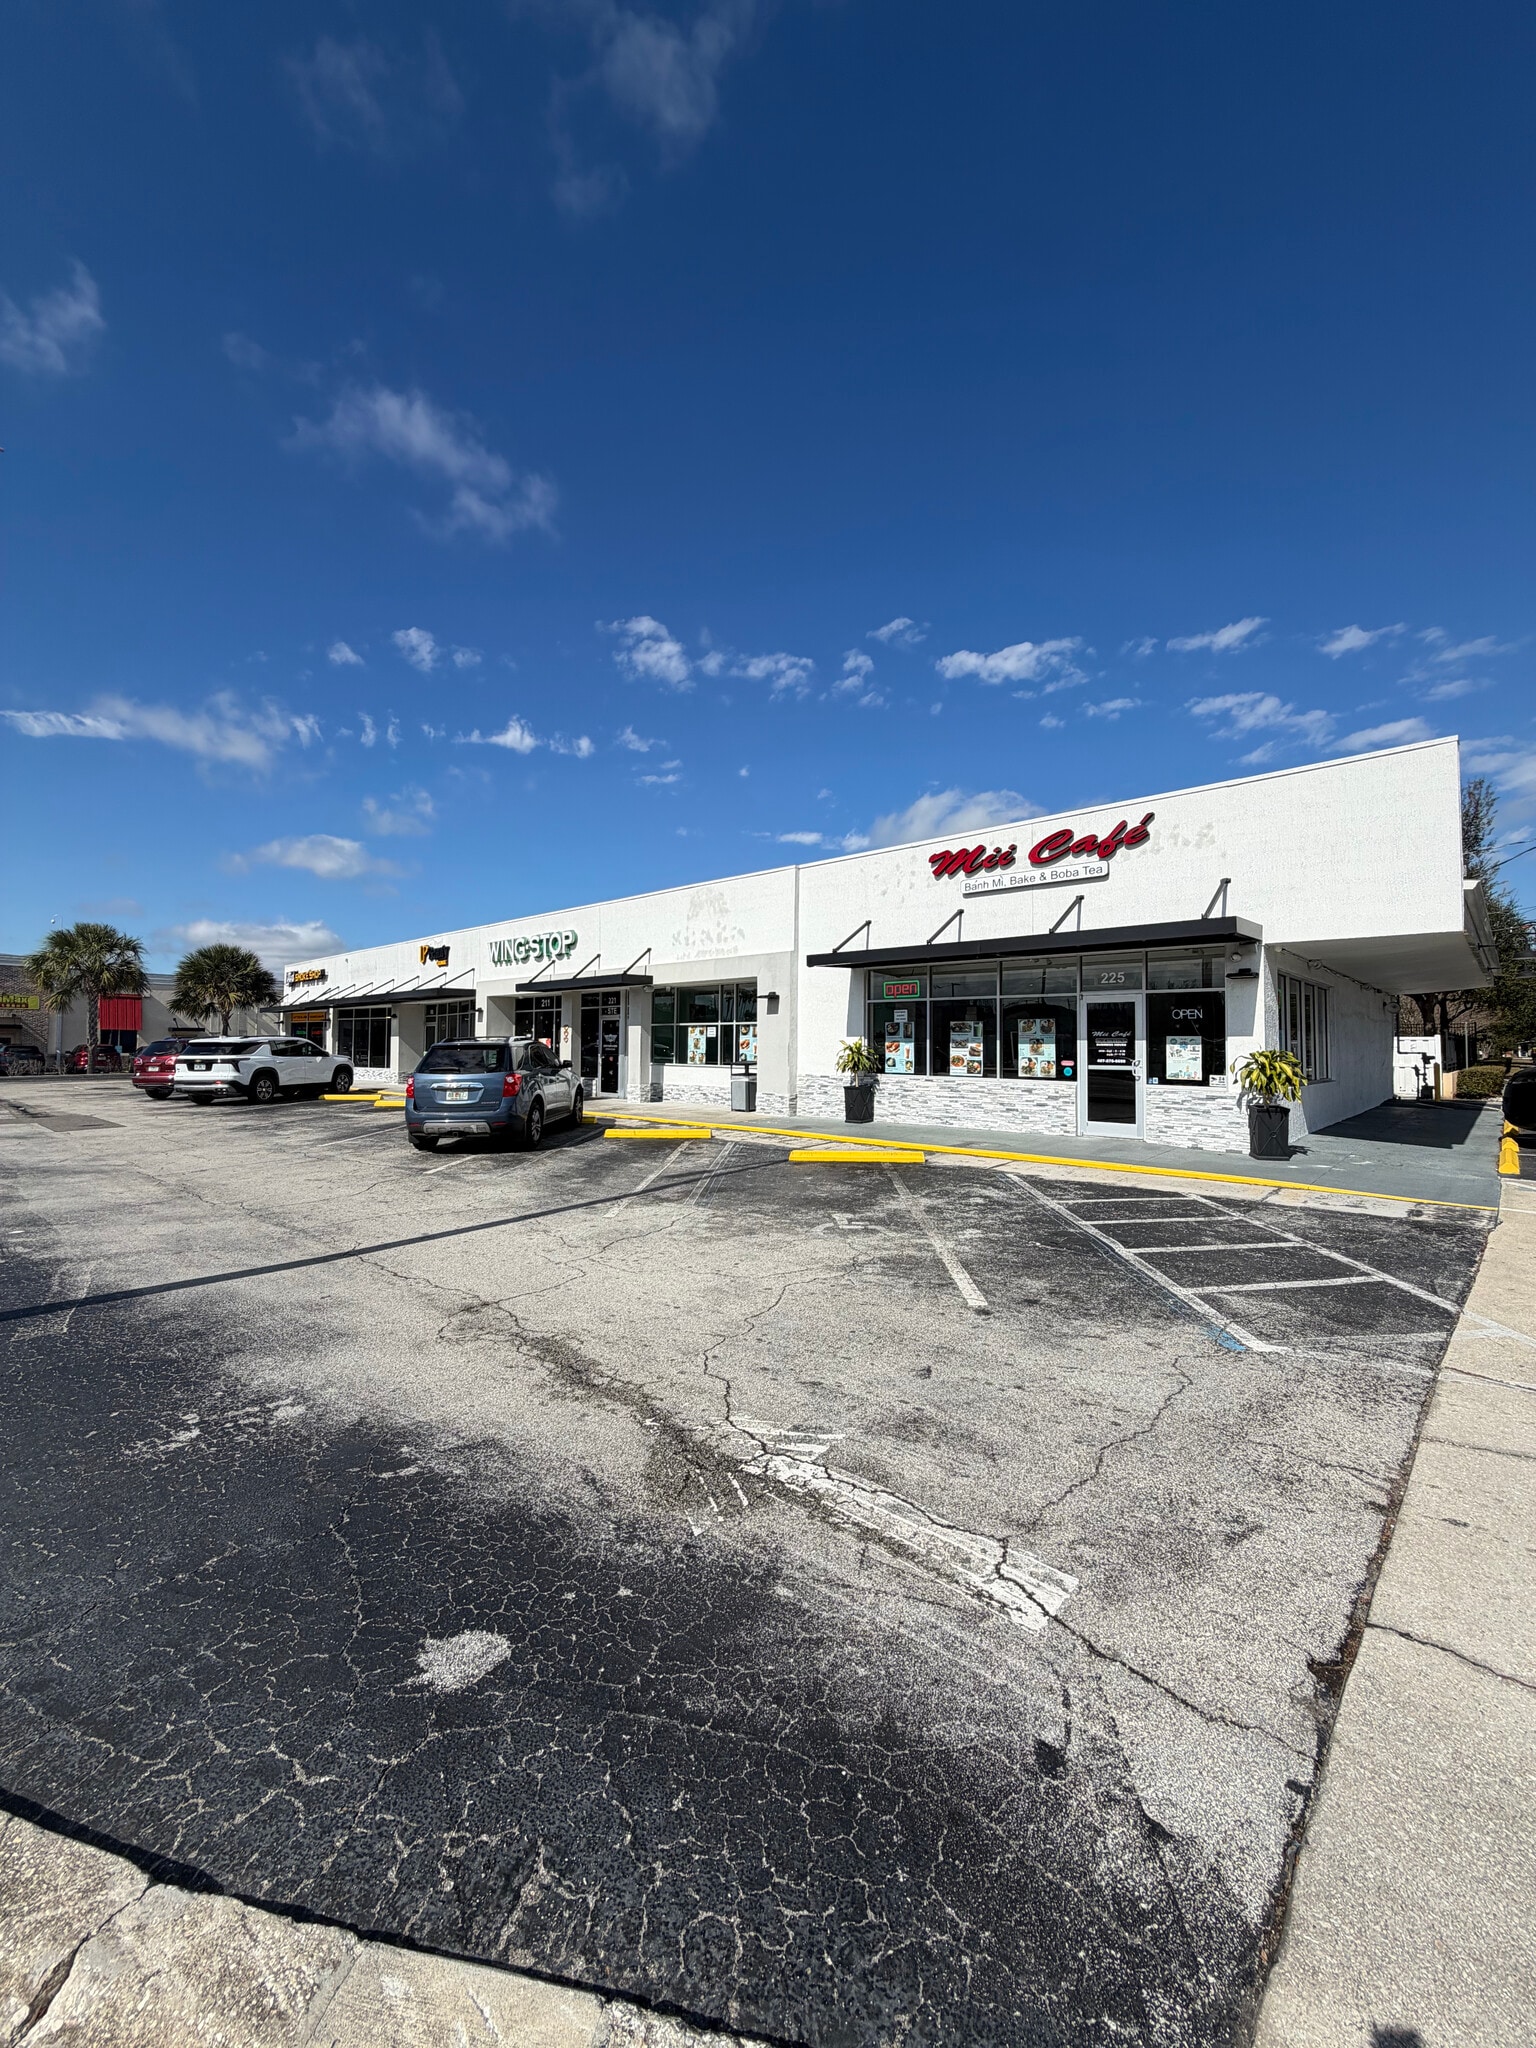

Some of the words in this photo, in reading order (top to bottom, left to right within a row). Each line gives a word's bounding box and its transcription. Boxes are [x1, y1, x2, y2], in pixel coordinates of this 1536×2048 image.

[928, 844, 1017, 877] Mii
[1028, 812, 1155, 864] Café
[964, 879, 989, 892] Bánh
[1010, 874, 1036, 886] Bake
[1039, 871, 1047, 881] &
[1050, 868, 1079, 880] Boba
[1082, 865, 1103, 876] Tea
[487, 930, 578, 962] WINGSTOP
[1101, 971, 1125, 984] 225
[886, 983, 917, 998] open
[541, 999, 551, 1007] 211
[1171, 1008, 1203, 1020] OPEN
